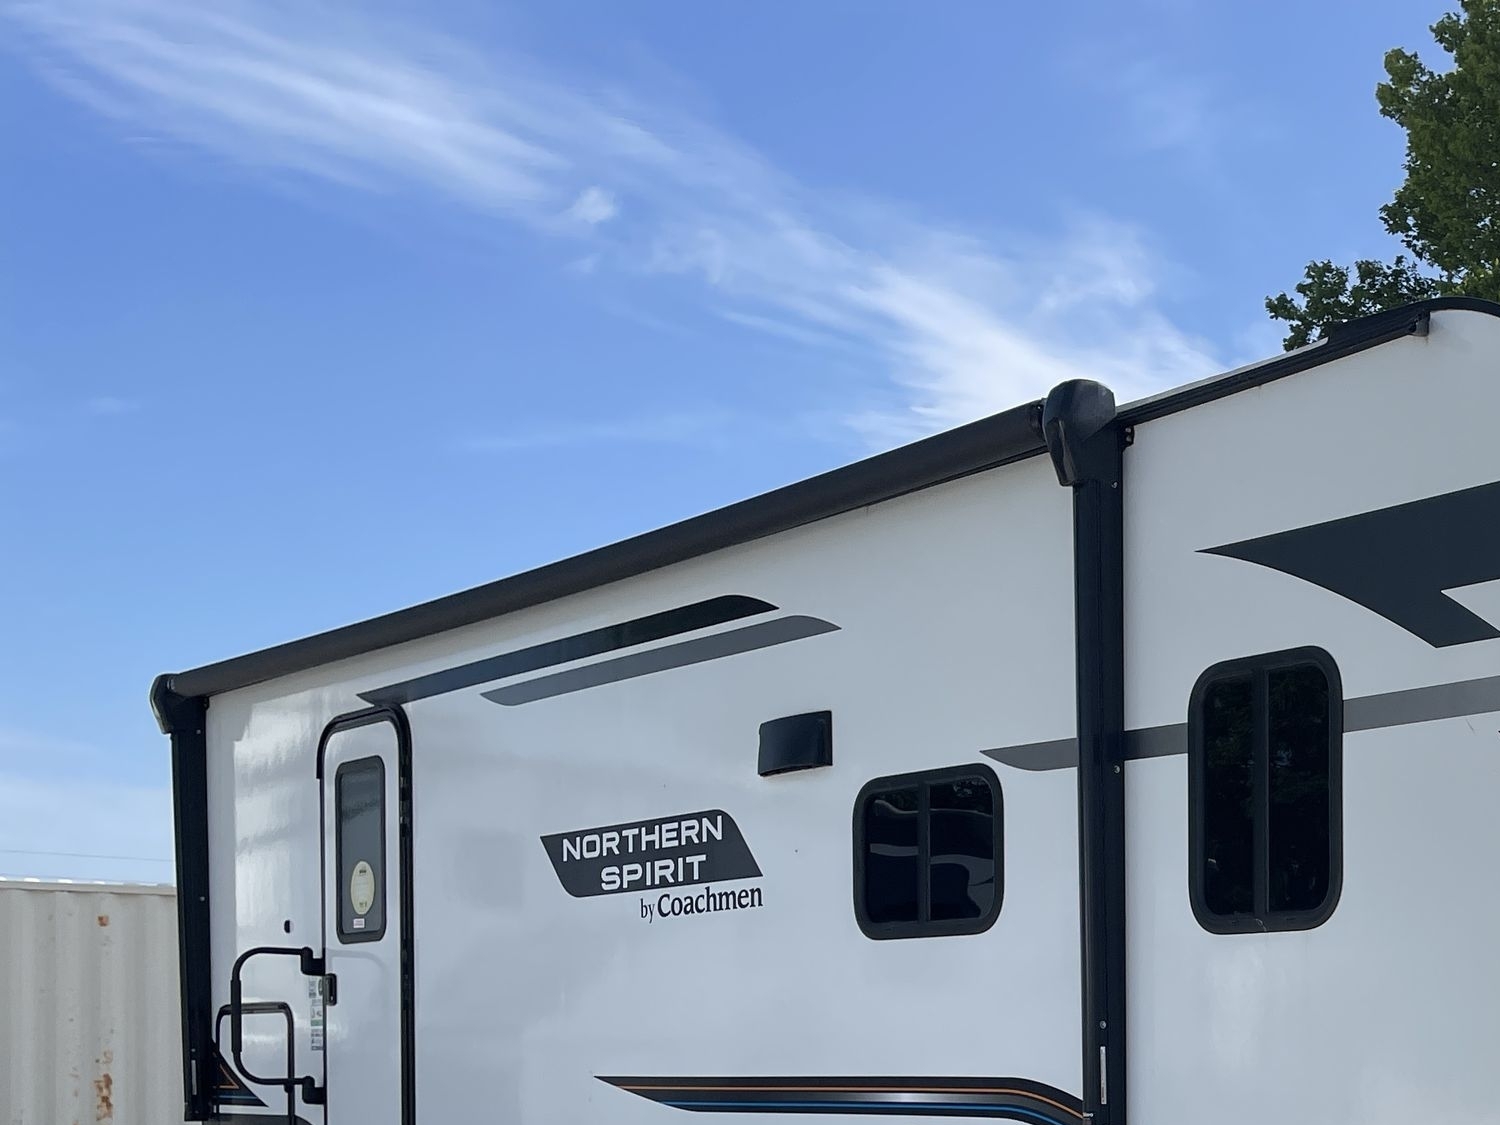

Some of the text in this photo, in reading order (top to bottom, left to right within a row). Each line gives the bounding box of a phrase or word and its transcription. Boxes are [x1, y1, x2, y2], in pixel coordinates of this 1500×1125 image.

[562, 815, 723, 862] NORTHERN
[600, 854, 707, 891] SPIRIT
[640, 886, 764, 923] by Coachmen
